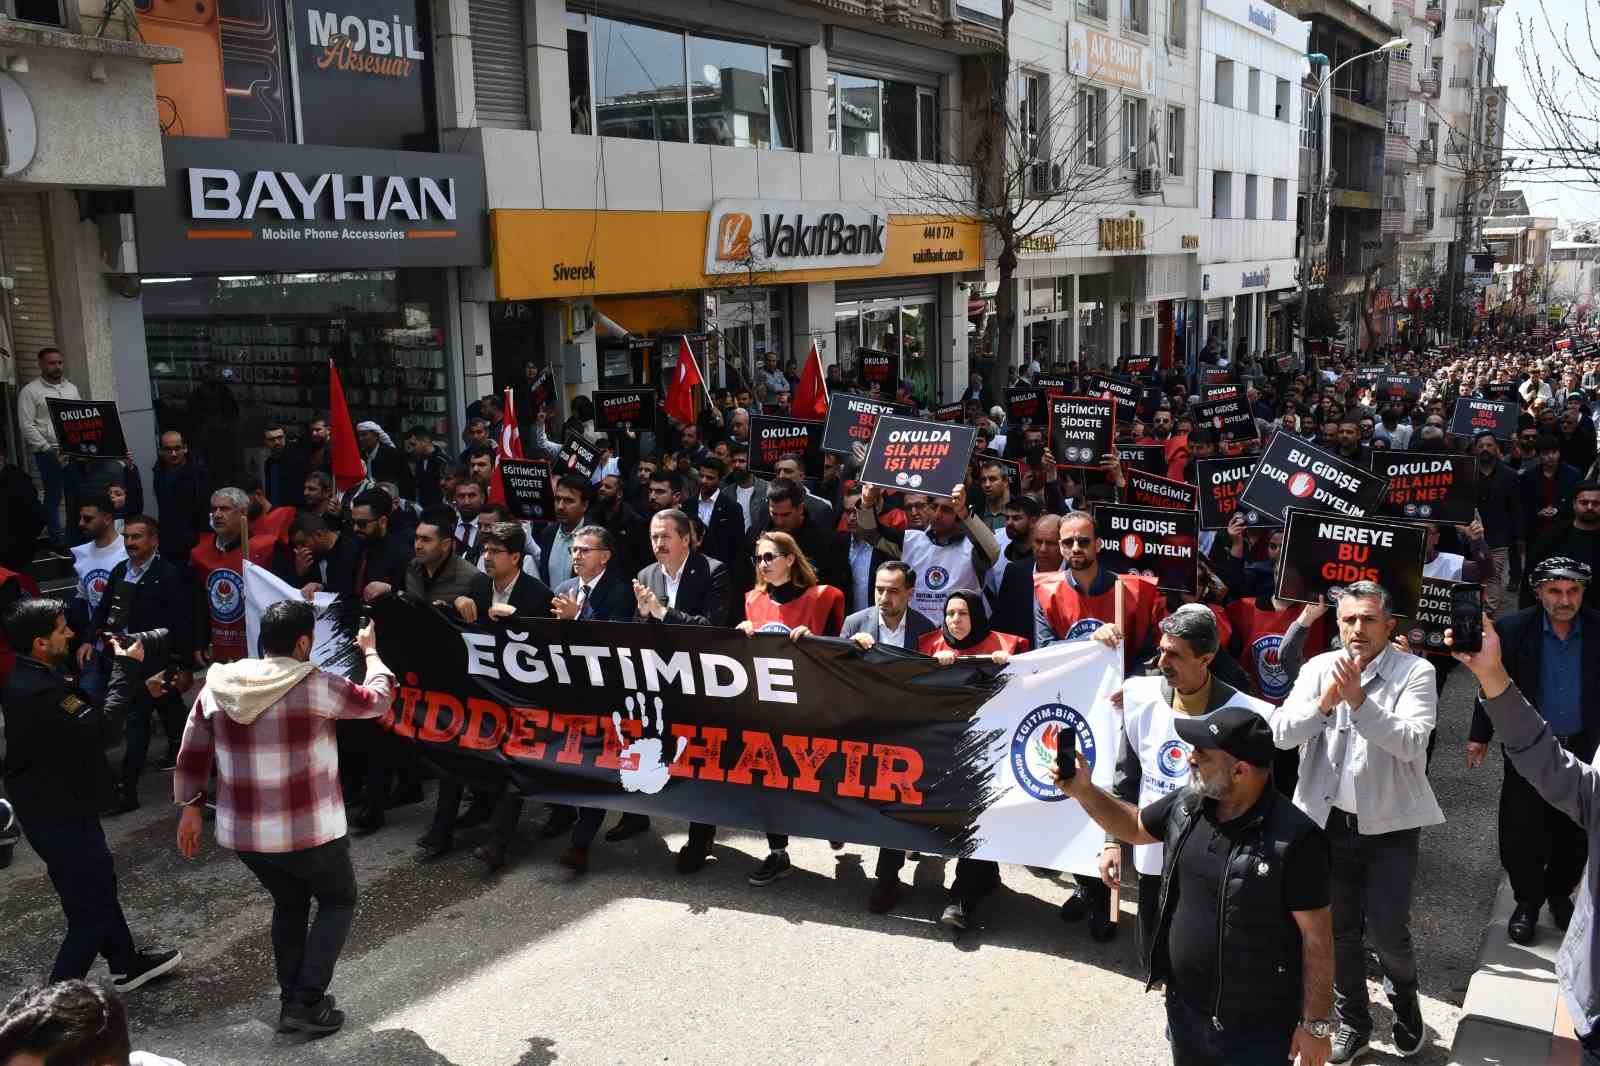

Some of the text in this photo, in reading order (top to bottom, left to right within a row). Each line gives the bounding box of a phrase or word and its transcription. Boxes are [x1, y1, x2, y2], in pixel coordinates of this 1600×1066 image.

[308, 9, 424, 60] MOBİL
[318, 33, 412, 77] Aksesuar
[188, 167, 457, 220] BAYHAN
[262, 228, 405, 240] Mobile Phone Accessories
[761, 212, 884, 258] VakıfBank
[552, 261, 596, 281] Siverek
[1208, 386, 1237, 396] OKULDA
[604, 395, 640, 407] OKULDA
[1054, 403, 1111, 416] EĞİTİMCİYE
[1470, 402, 1504, 411] NEREYE
[60, 408, 101, 421] OKULDA
[1061, 416, 1102, 428] ŞİDDETE
[761, 426, 808, 438] OKULDA
[889, 430, 951, 443] OKULDA
[1065, 430, 1095, 440] HAYIR
[884, 443, 950, 457] SİLAHIN
[503, 464, 548, 477] EĞİTİMCİYE
[884, 458, 940, 472] İŞİ NE?
[1288, 449, 1361, 493] BU GİDİŞE
[1387, 459, 1453, 476] OKULDA
[1212, 464, 1255, 485] OKUL
[1132, 478, 1192, 502] YÜREĞİMİZ
[1261, 463, 1366, 518] DUR DİYELİM
[1111, 517, 1177, 536] BU GİDİŞE
[1318, 522, 1394, 548] NEREYE
[1145, 542, 1191, 558] DİYELİM
[1338, 543, 1369, 564] BU
[462, 629, 798, 704] EĞİTİMDE
[668, 722, 924, 805] HAYIR
